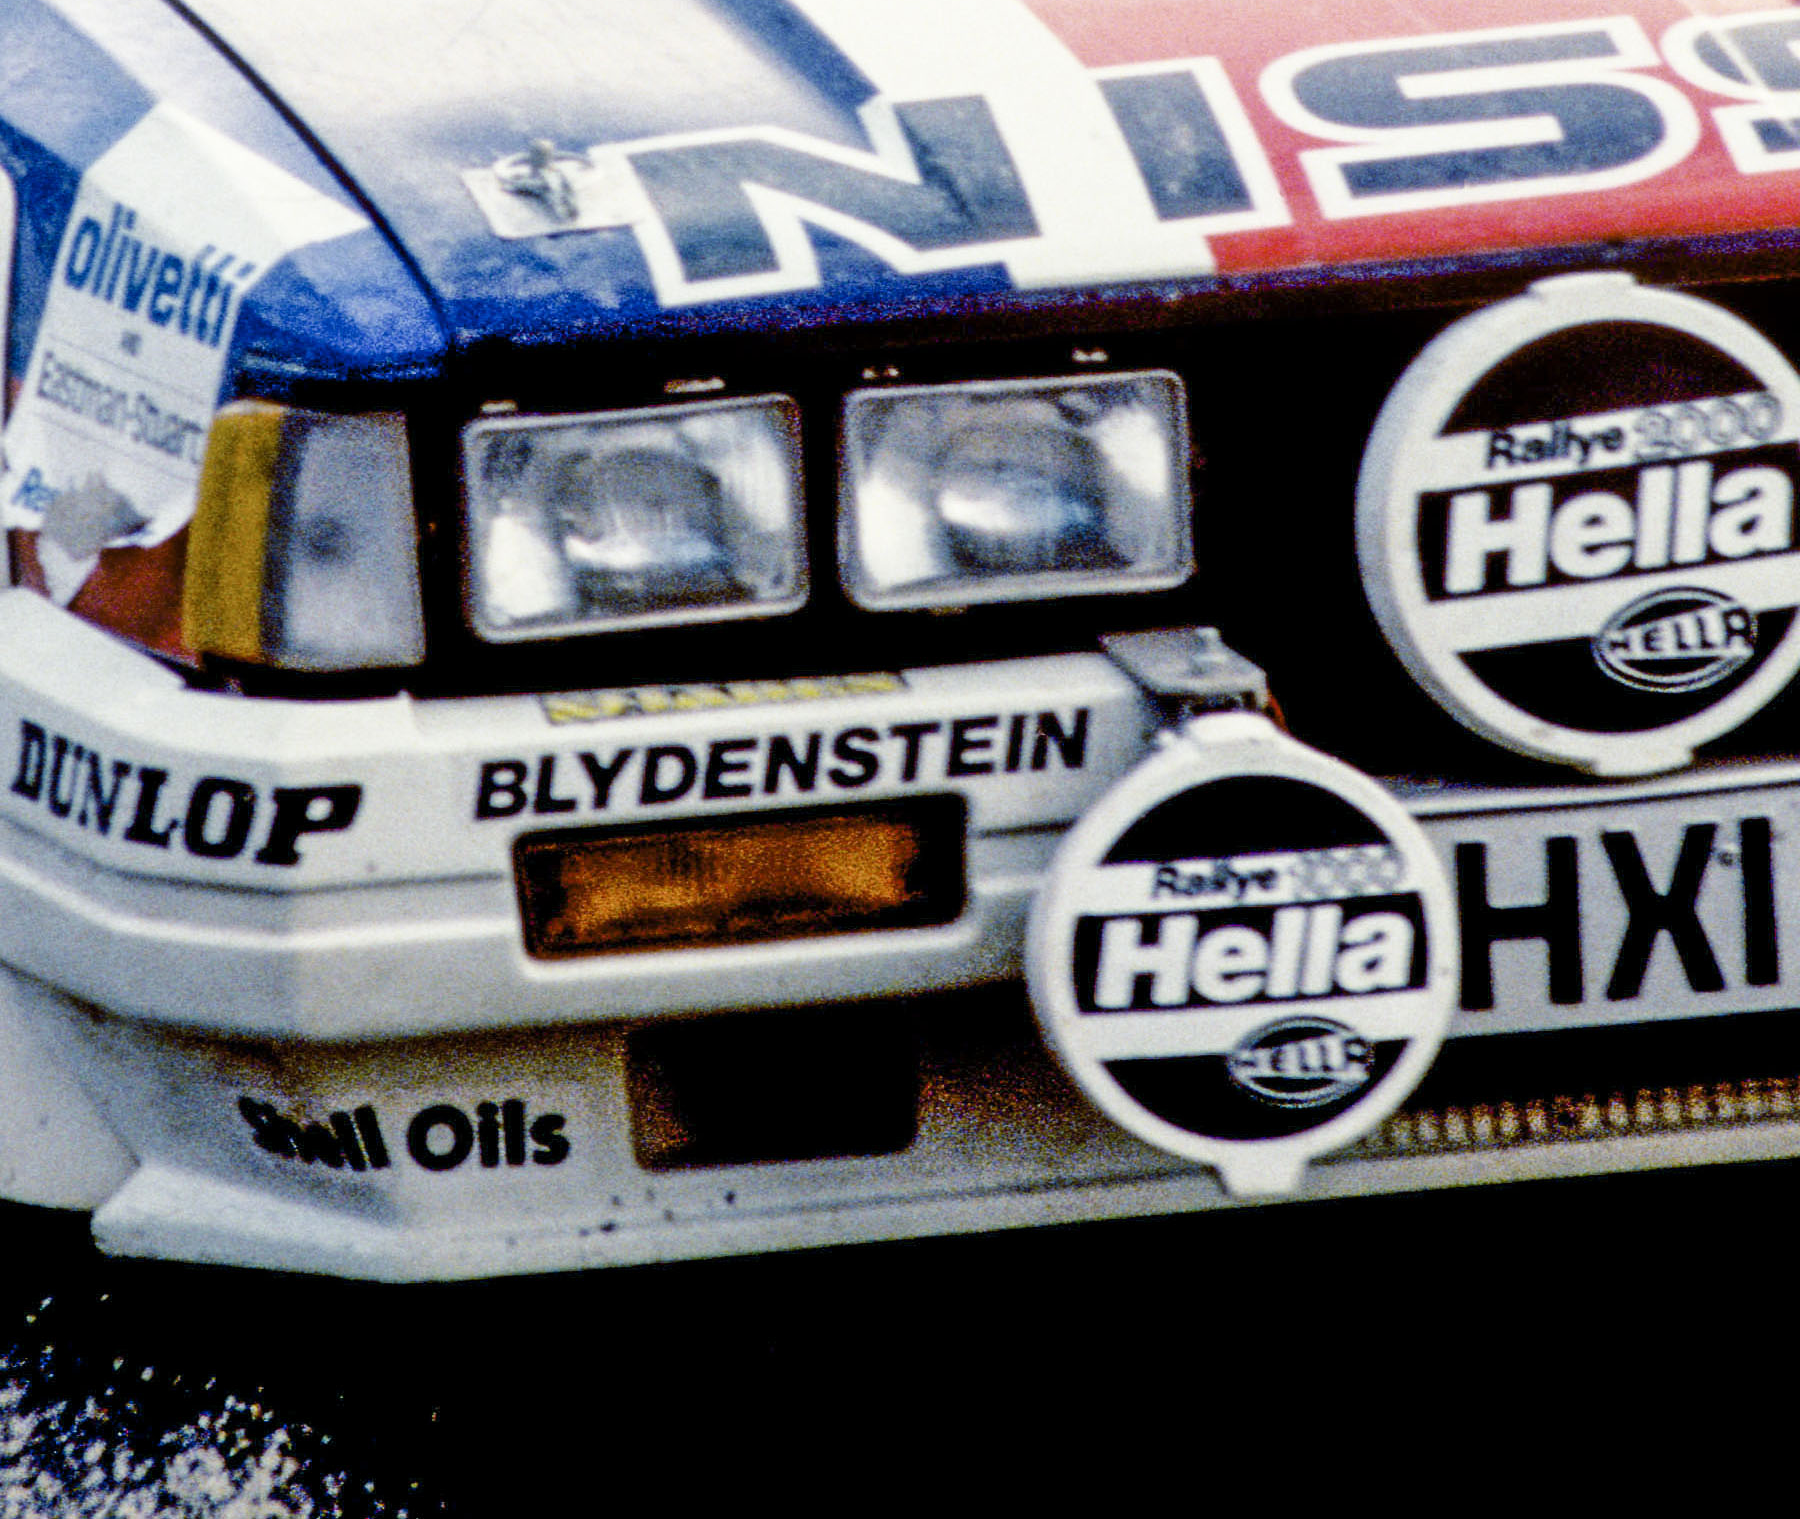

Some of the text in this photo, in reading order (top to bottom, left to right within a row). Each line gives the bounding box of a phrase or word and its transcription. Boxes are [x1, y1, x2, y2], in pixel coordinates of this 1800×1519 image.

[64, 202, 255, 349] olivetti
[1486, 419, 1625, 469] Rallye
[1444, 461, 1795, 595] Hella
[11, 719, 363, 865] DUNLOP
[475, 709, 1088, 821] BLYDENSTEIN
[1095, 904, 1415, 1008] Hella
[1455, 816, 1779, 1013] HXI
[406, 1098, 571, 1172] Oils
